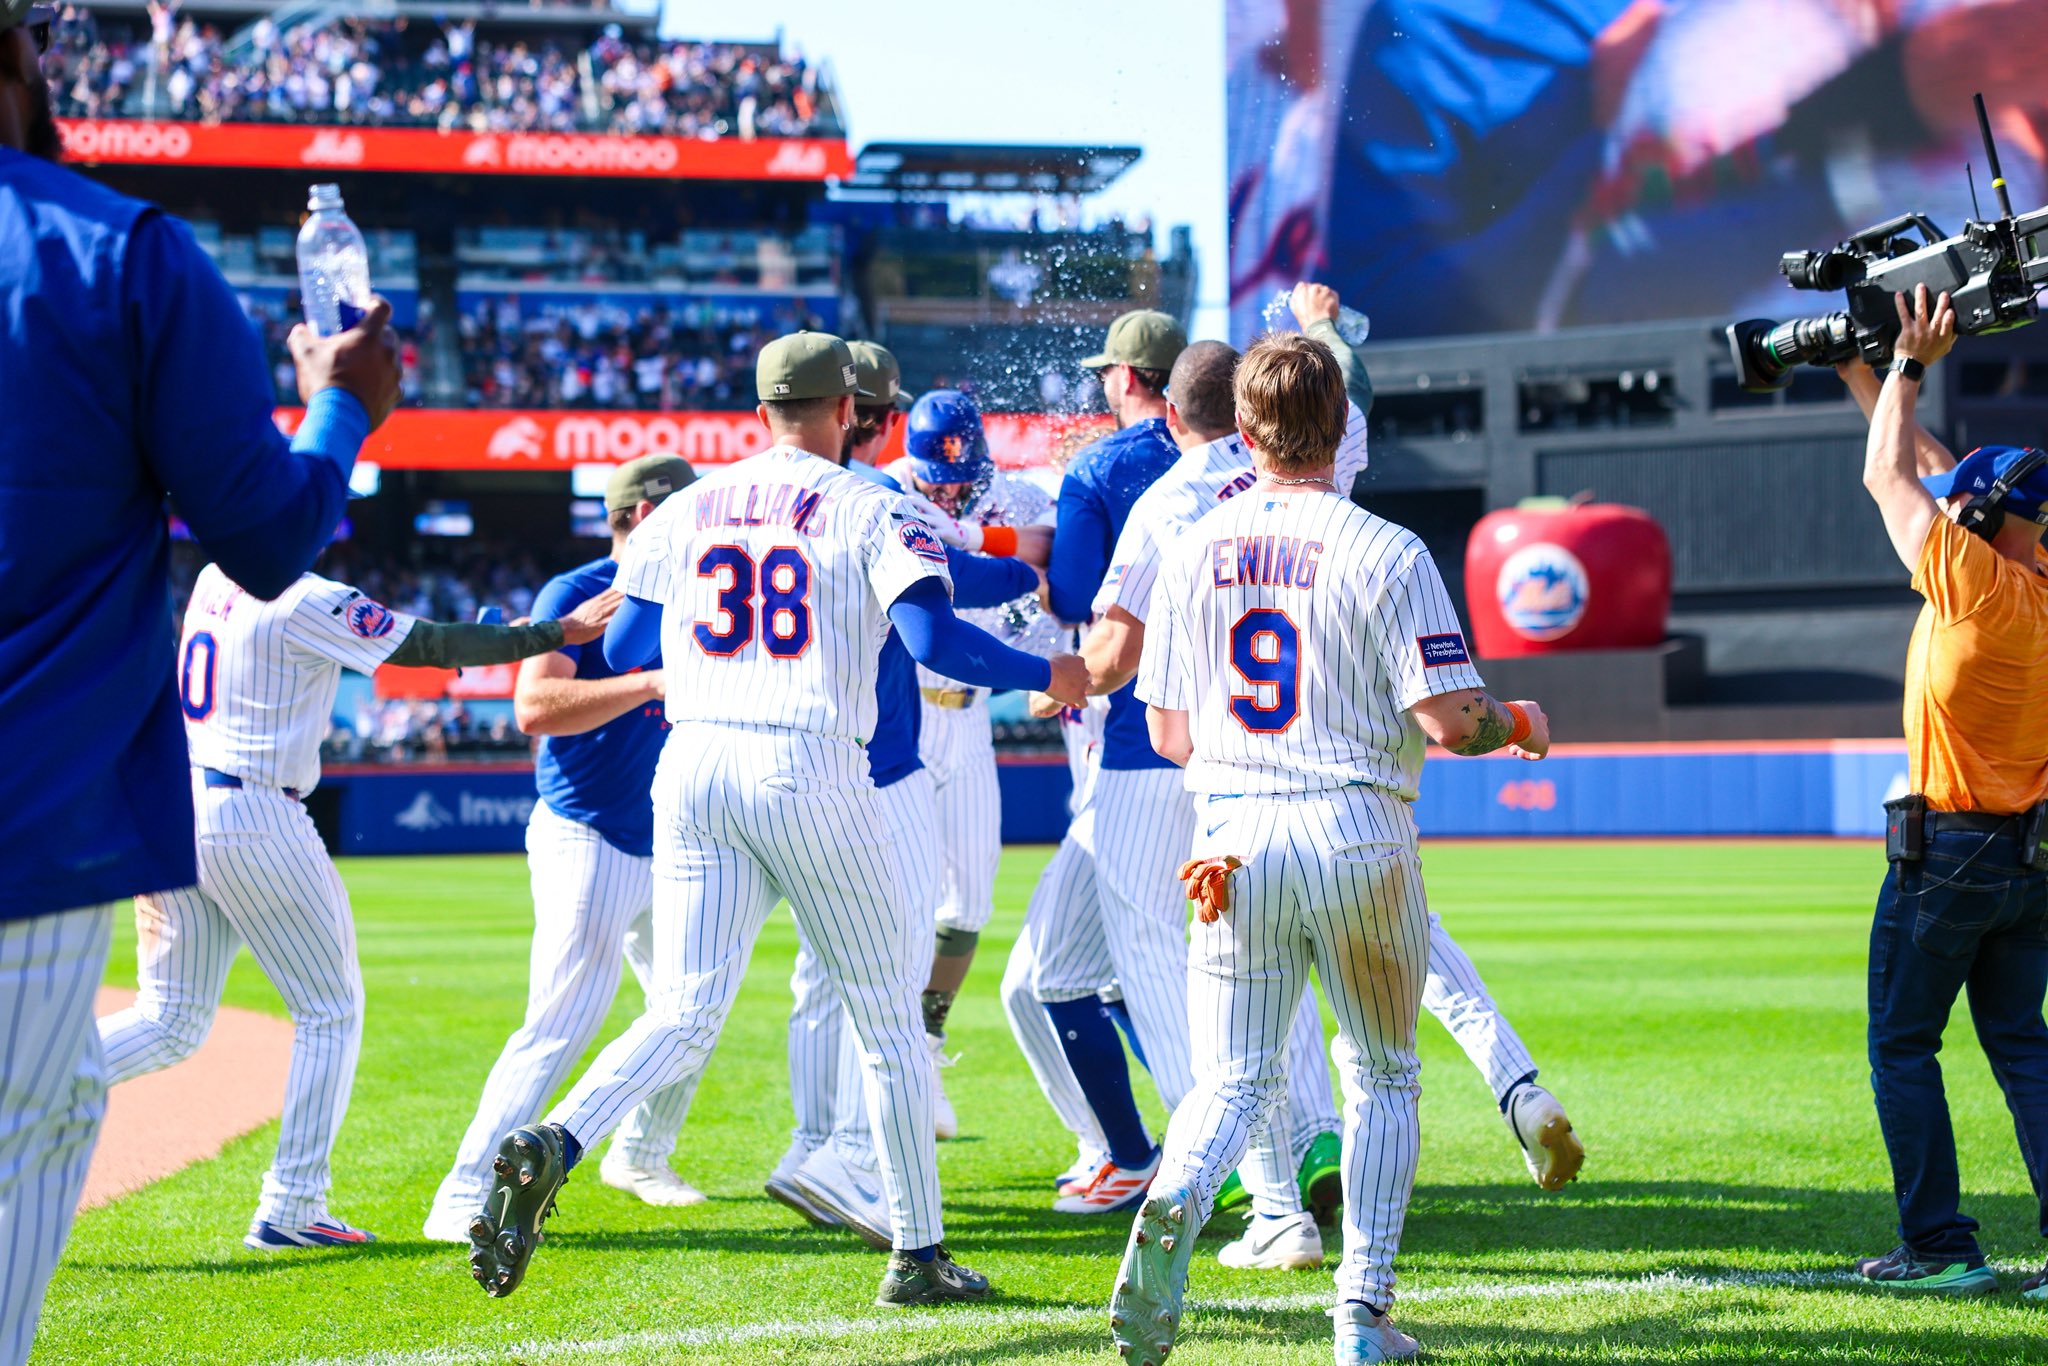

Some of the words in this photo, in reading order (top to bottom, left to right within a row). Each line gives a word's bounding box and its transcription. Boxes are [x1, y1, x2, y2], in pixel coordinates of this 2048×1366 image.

[506, 136, 679, 171] moomoo
[696, 483, 834, 538] WILLIAMS
[1213, 535, 1324, 591] EWING
[691, 543, 813, 659] 38
[181, 628, 220, 724] 0
[1230, 607, 1301, 734] 9
[1431, 647, 1465, 658] Presbyterian
